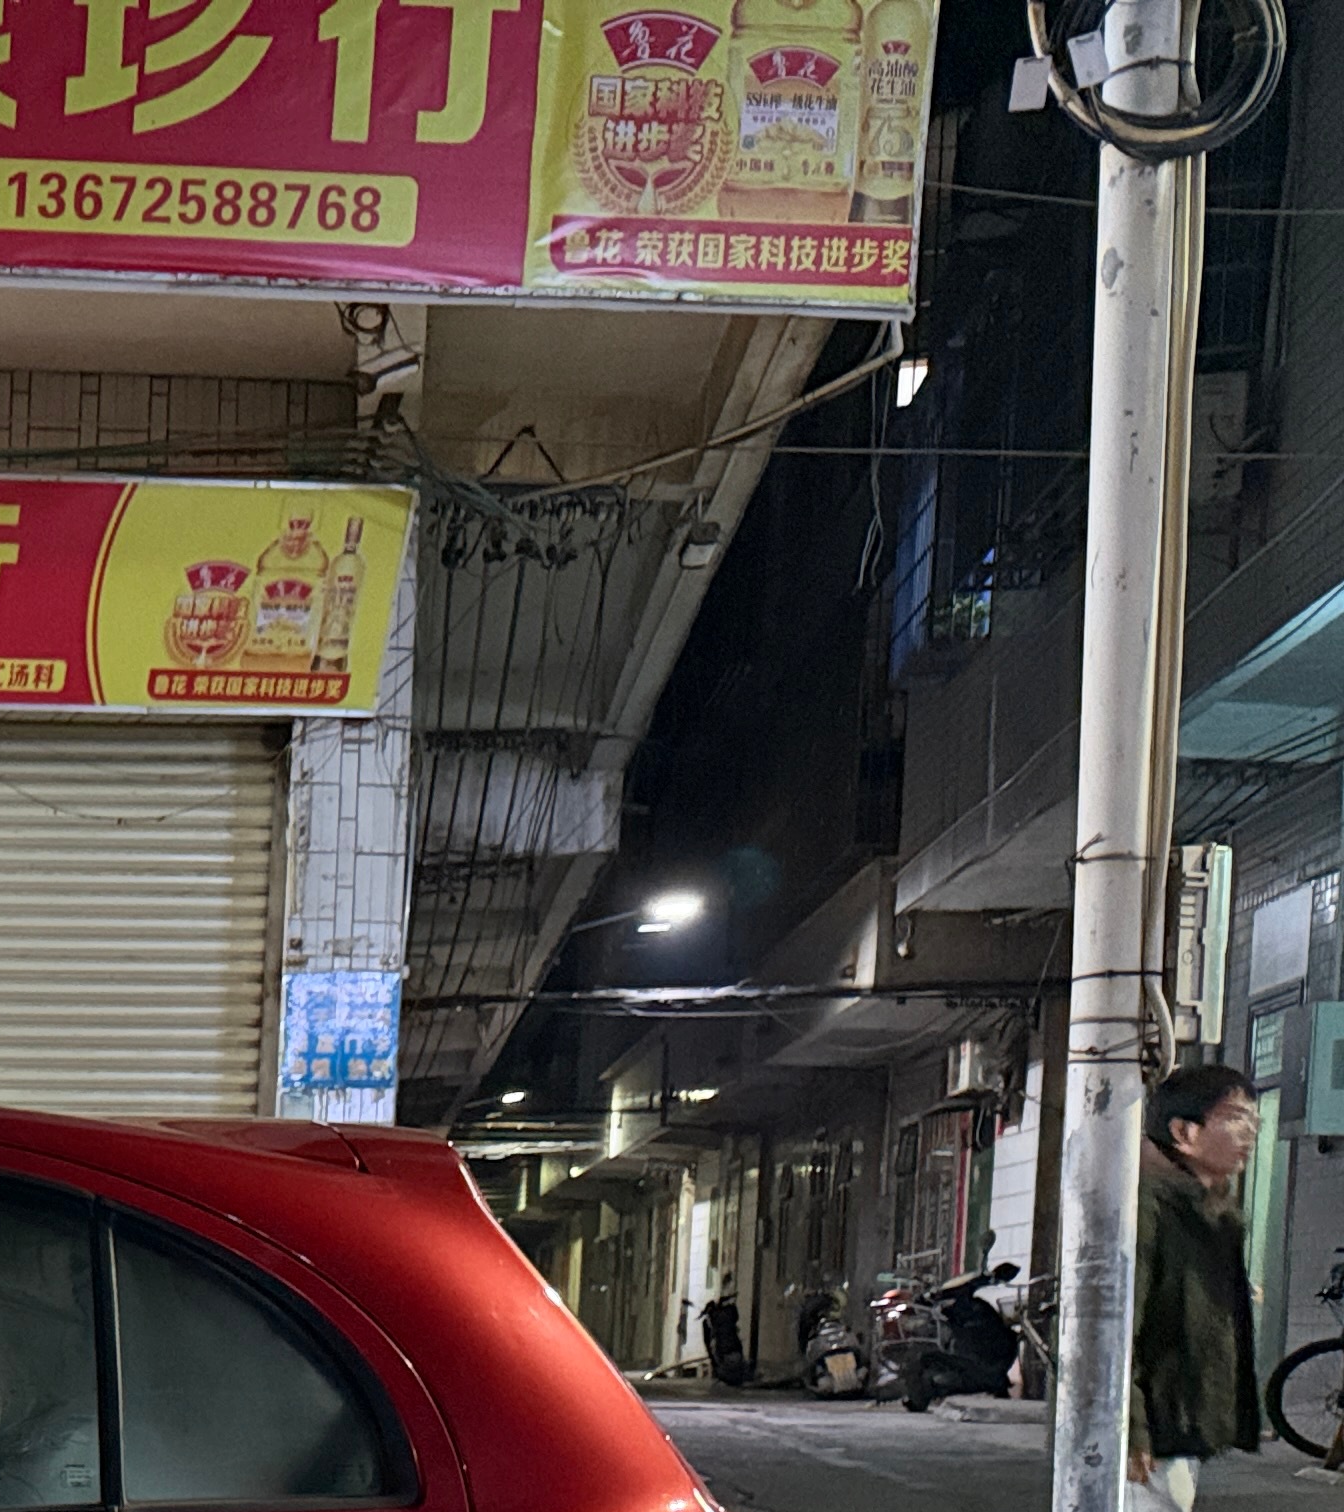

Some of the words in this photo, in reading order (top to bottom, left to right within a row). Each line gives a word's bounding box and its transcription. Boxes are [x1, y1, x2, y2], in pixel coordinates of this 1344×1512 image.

[589, 75, 724, 120] 国家科技
[6, 172, 382, 233] 13672588768
[635, 231, 910, 276] 荣获国家科技进步奖
